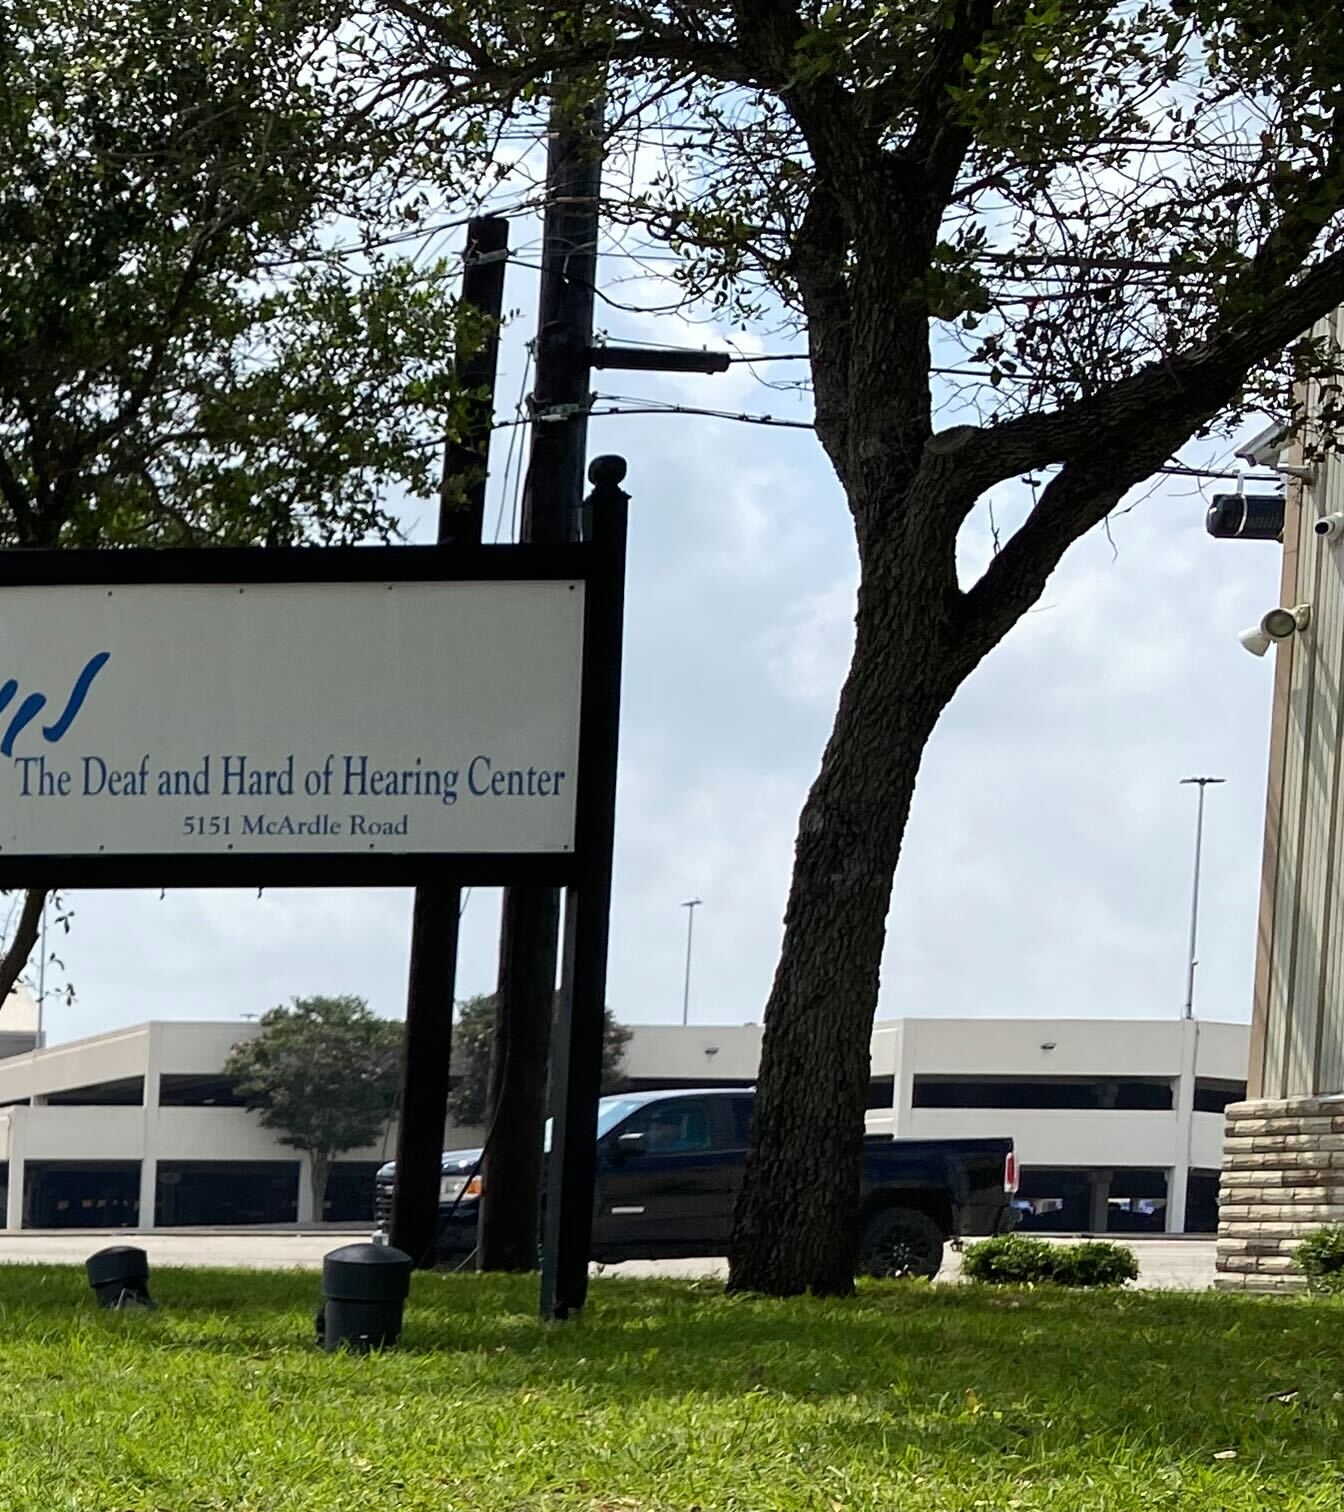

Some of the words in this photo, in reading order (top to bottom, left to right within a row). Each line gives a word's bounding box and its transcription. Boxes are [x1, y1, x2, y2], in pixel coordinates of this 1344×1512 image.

[14, 755, 71, 796] The
[81, 754, 150, 796] Deaf
[158, 754, 211, 796] and
[221, 754, 294, 796] Hard
[304, 754, 334, 796] of
[342, 755, 459, 805] Hearing
[467, 755, 565, 797] Center
[183, 815, 230, 836] 5151
[241, 814, 341, 836] McArdle
[350, 814, 409, 836] Road
